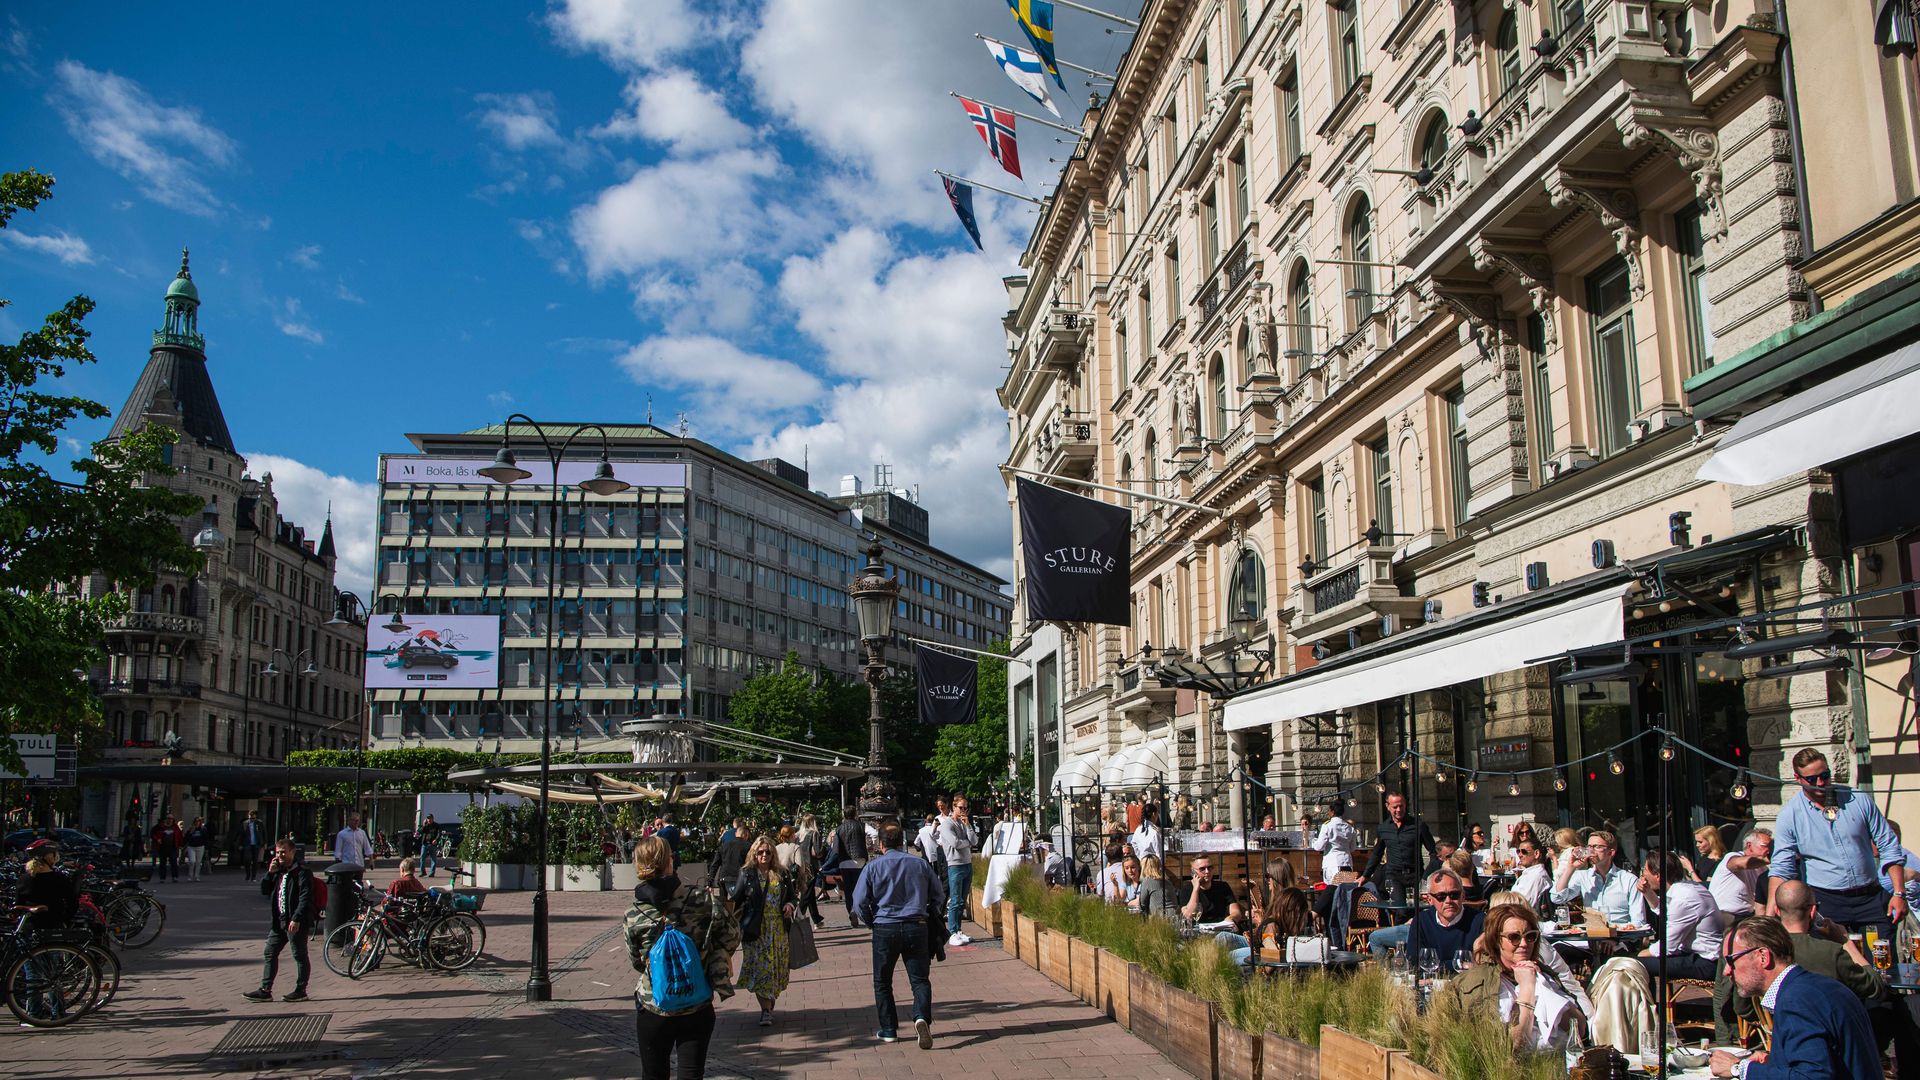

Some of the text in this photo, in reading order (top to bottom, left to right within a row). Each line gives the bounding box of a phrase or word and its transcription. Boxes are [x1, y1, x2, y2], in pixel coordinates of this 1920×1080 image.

[426, 466, 454, 477] Boka,
[456, 466, 470, 477] lås
[1044, 547, 1116, 573] STURE
[1060, 566, 1102, 575] GALLERIAN
[929, 685, 967, 698] STURE
[17, 739, 53, 749] TULL
